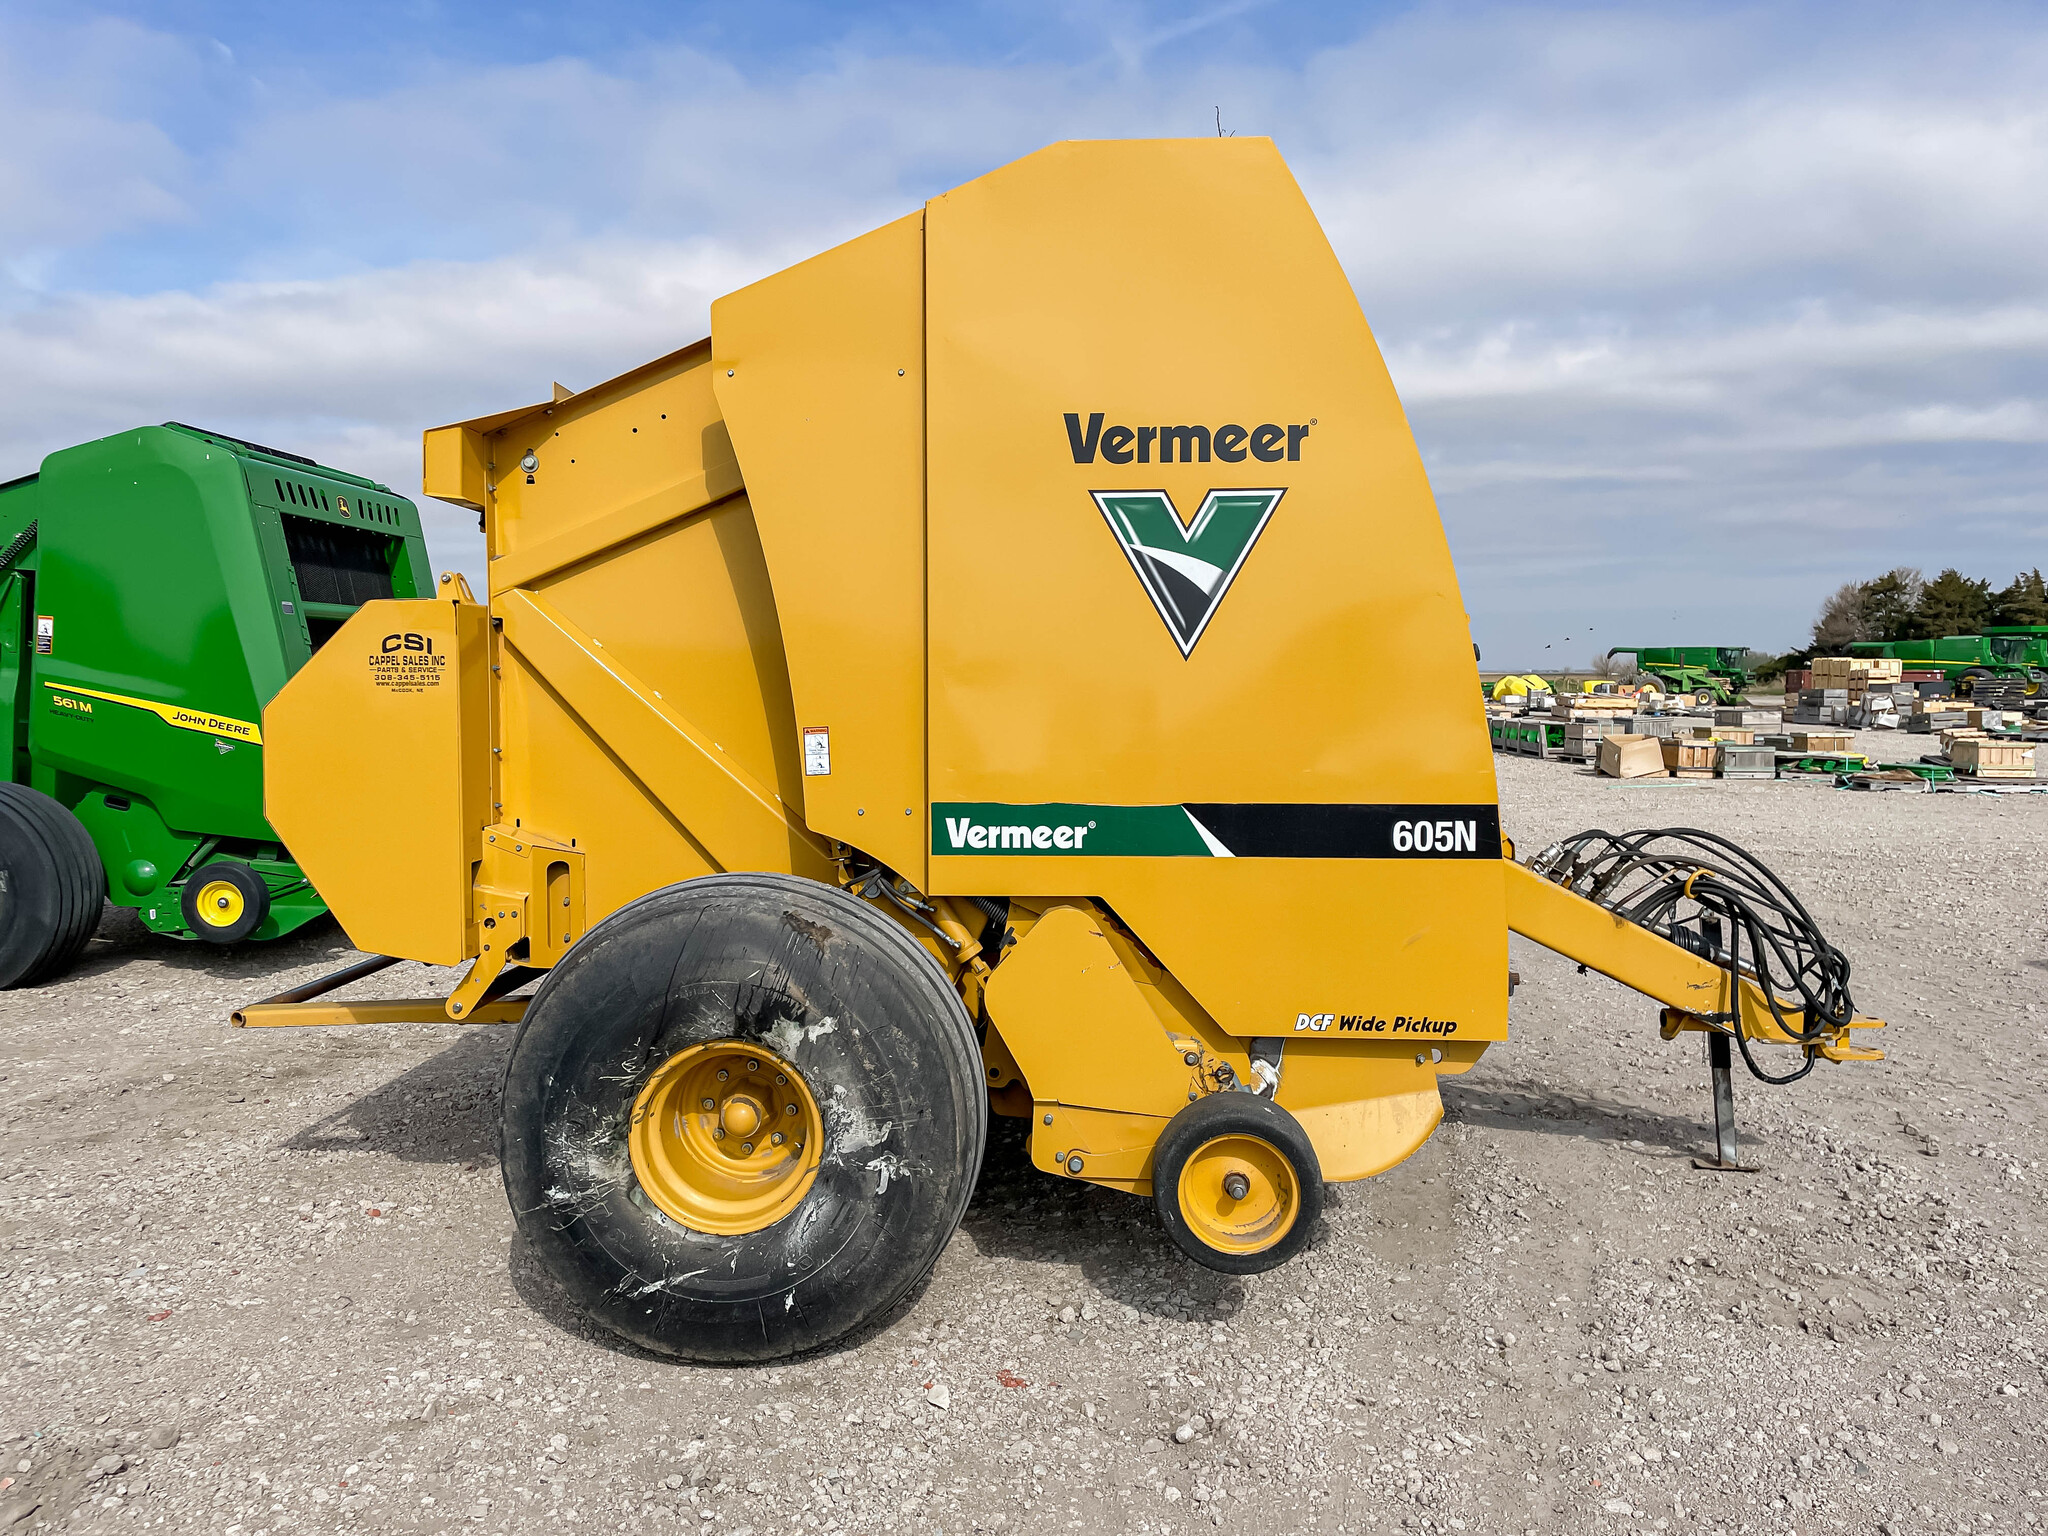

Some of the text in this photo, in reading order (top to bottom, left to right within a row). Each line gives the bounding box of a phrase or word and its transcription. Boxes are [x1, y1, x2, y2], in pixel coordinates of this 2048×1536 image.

[381, 632, 433, 656] CSI
[368, 655, 446, 666] CAPPEL SALES INC
[172, 711, 251, 736] JOHN DEERE
[1392, 820, 1477, 852] 605N
[1294, 1013, 1458, 1037] DCF Wide Pickup
